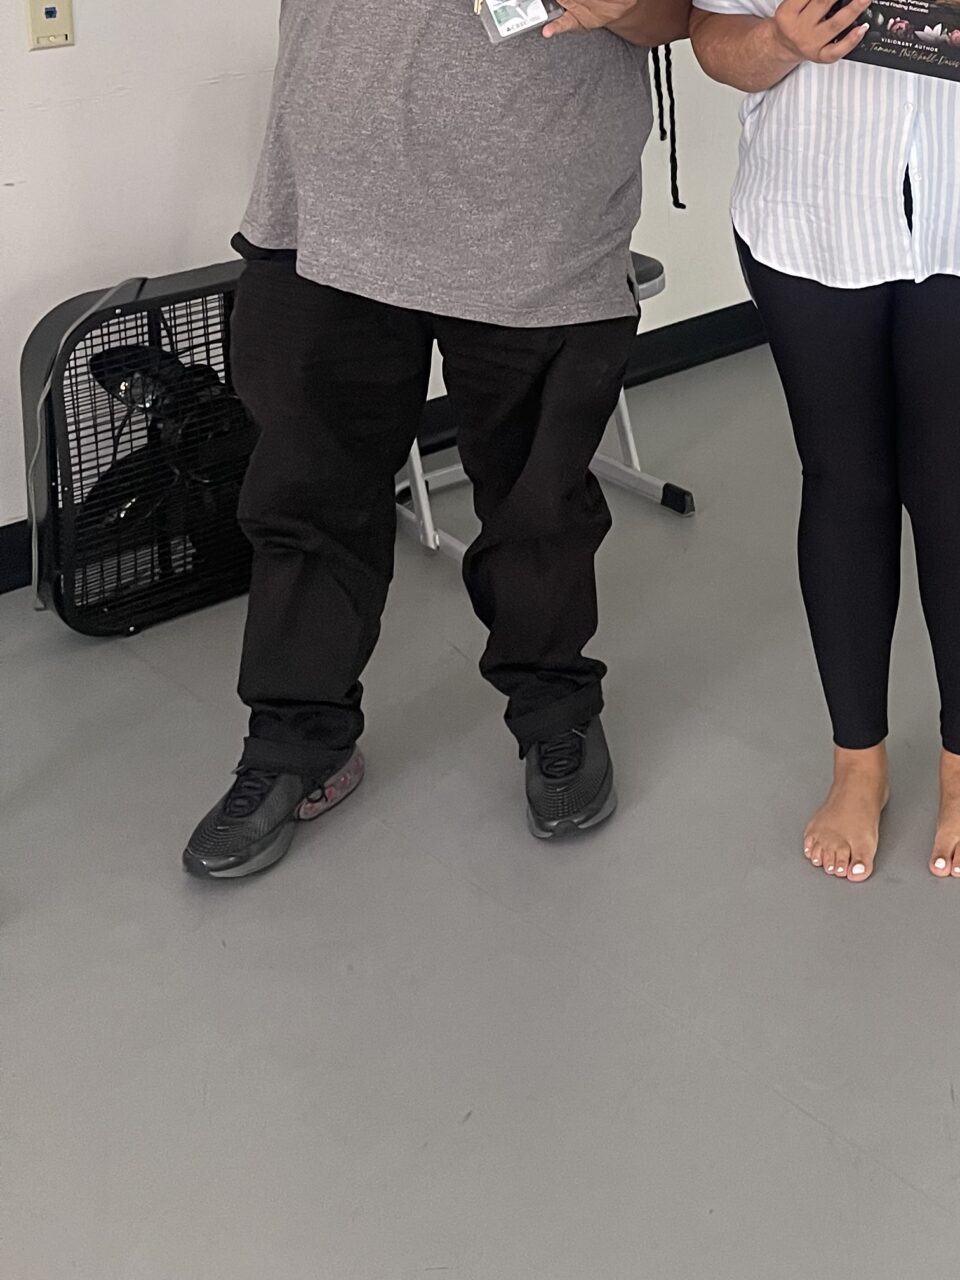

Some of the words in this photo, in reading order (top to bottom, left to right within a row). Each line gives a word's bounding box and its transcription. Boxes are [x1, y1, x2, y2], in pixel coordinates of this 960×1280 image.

[890, 1, 908, 11] Finding
[909, 5, 929, 14] Success
[869, 42, 897, 54] Tamara
[881, 37, 913, 47] VISIONARY
[914, 44, 938, 52] AUTHOR
